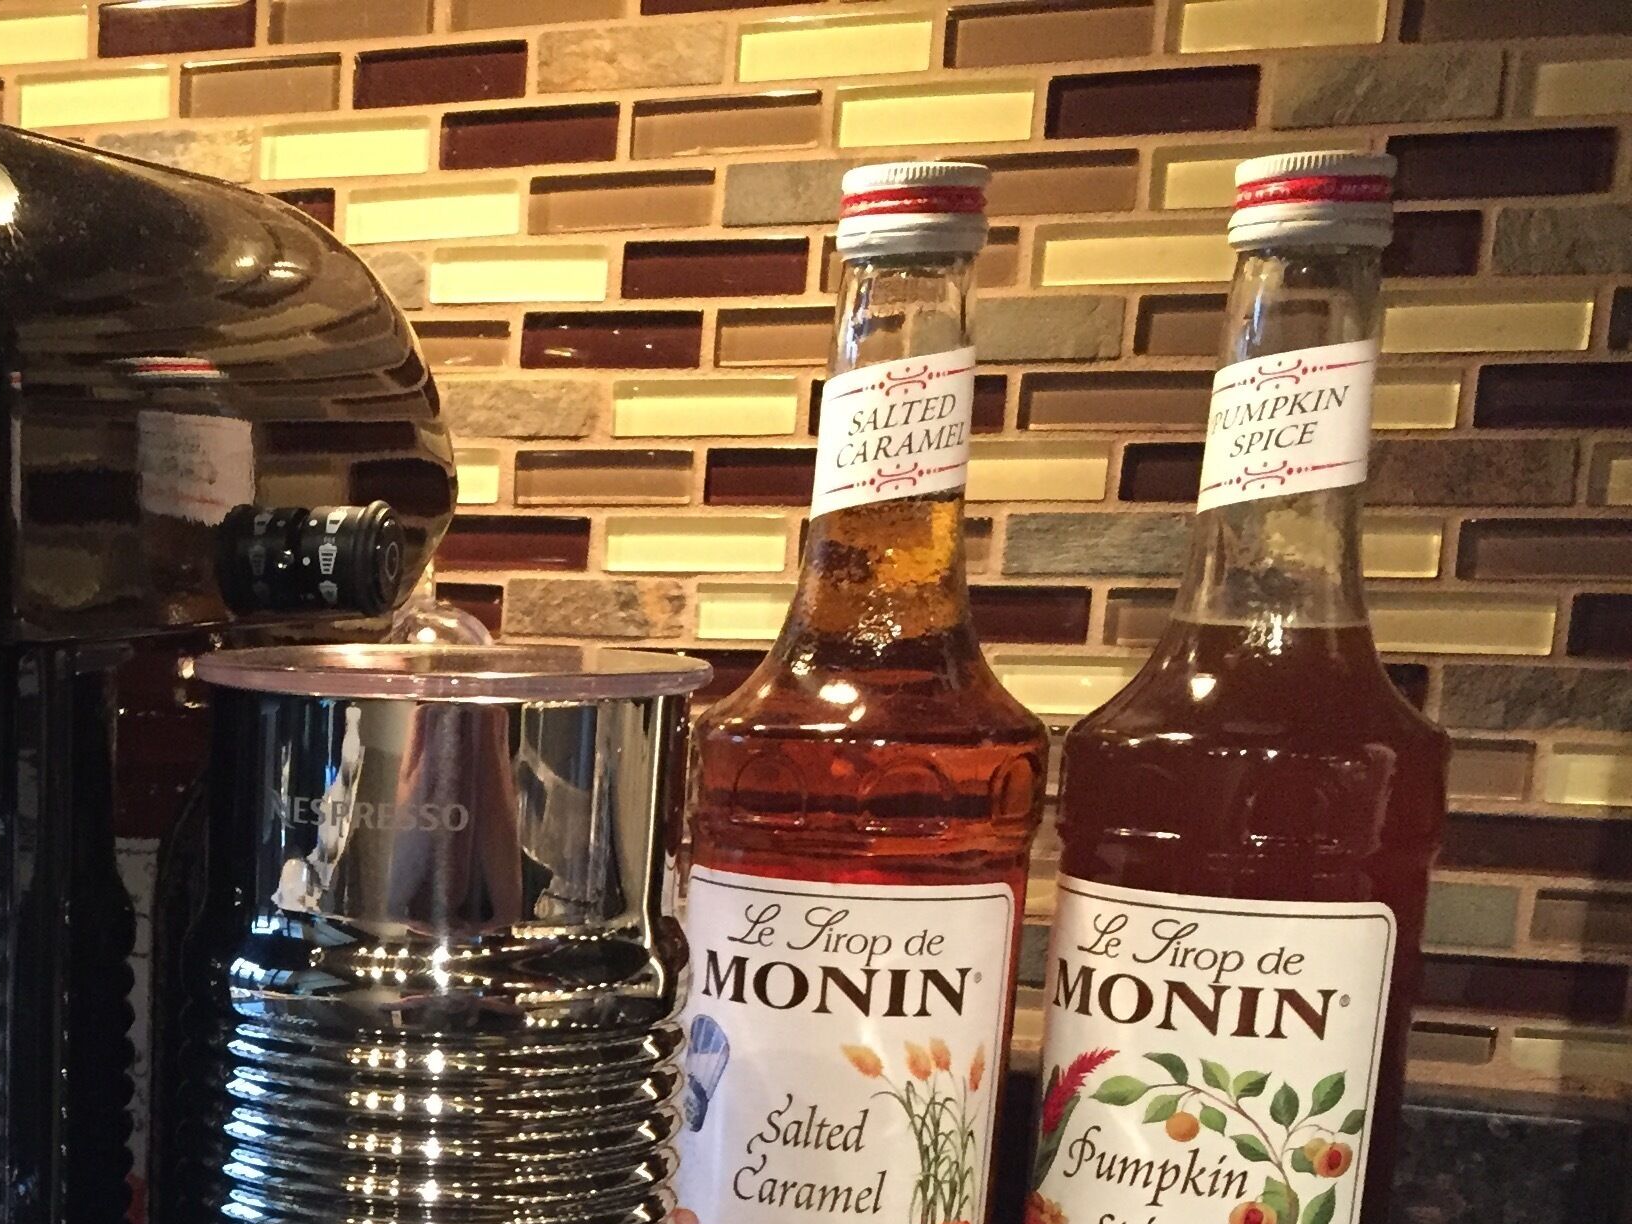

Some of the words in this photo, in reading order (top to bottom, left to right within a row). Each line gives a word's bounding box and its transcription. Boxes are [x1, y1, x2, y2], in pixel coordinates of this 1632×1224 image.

[848, 393, 956, 436] SALTED
[1211, 385, 1350, 436] PUMPKIN
[1229, 421, 1318, 458] SPICE
[836, 421, 965, 468] CARAMEL
[263, 786, 469, 845] NESPRESSO
[728, 903, 781, 948] Le
[786, 906, 892, 970] Sirop
[904, 929, 945, 957] de
[1077, 913, 1129, 959] Le
[1133, 918, 1245, 984] Sirop
[1257, 946, 1305, 976] de
[701, 950, 972, 1017] MONIN
[1053, 957, 1339, 1041] MONIN
[746, 1093, 869, 1154] Salted
[733, 1154, 886, 1215] Caramel
[1063, 1126, 1250, 1208] Pumpkin
